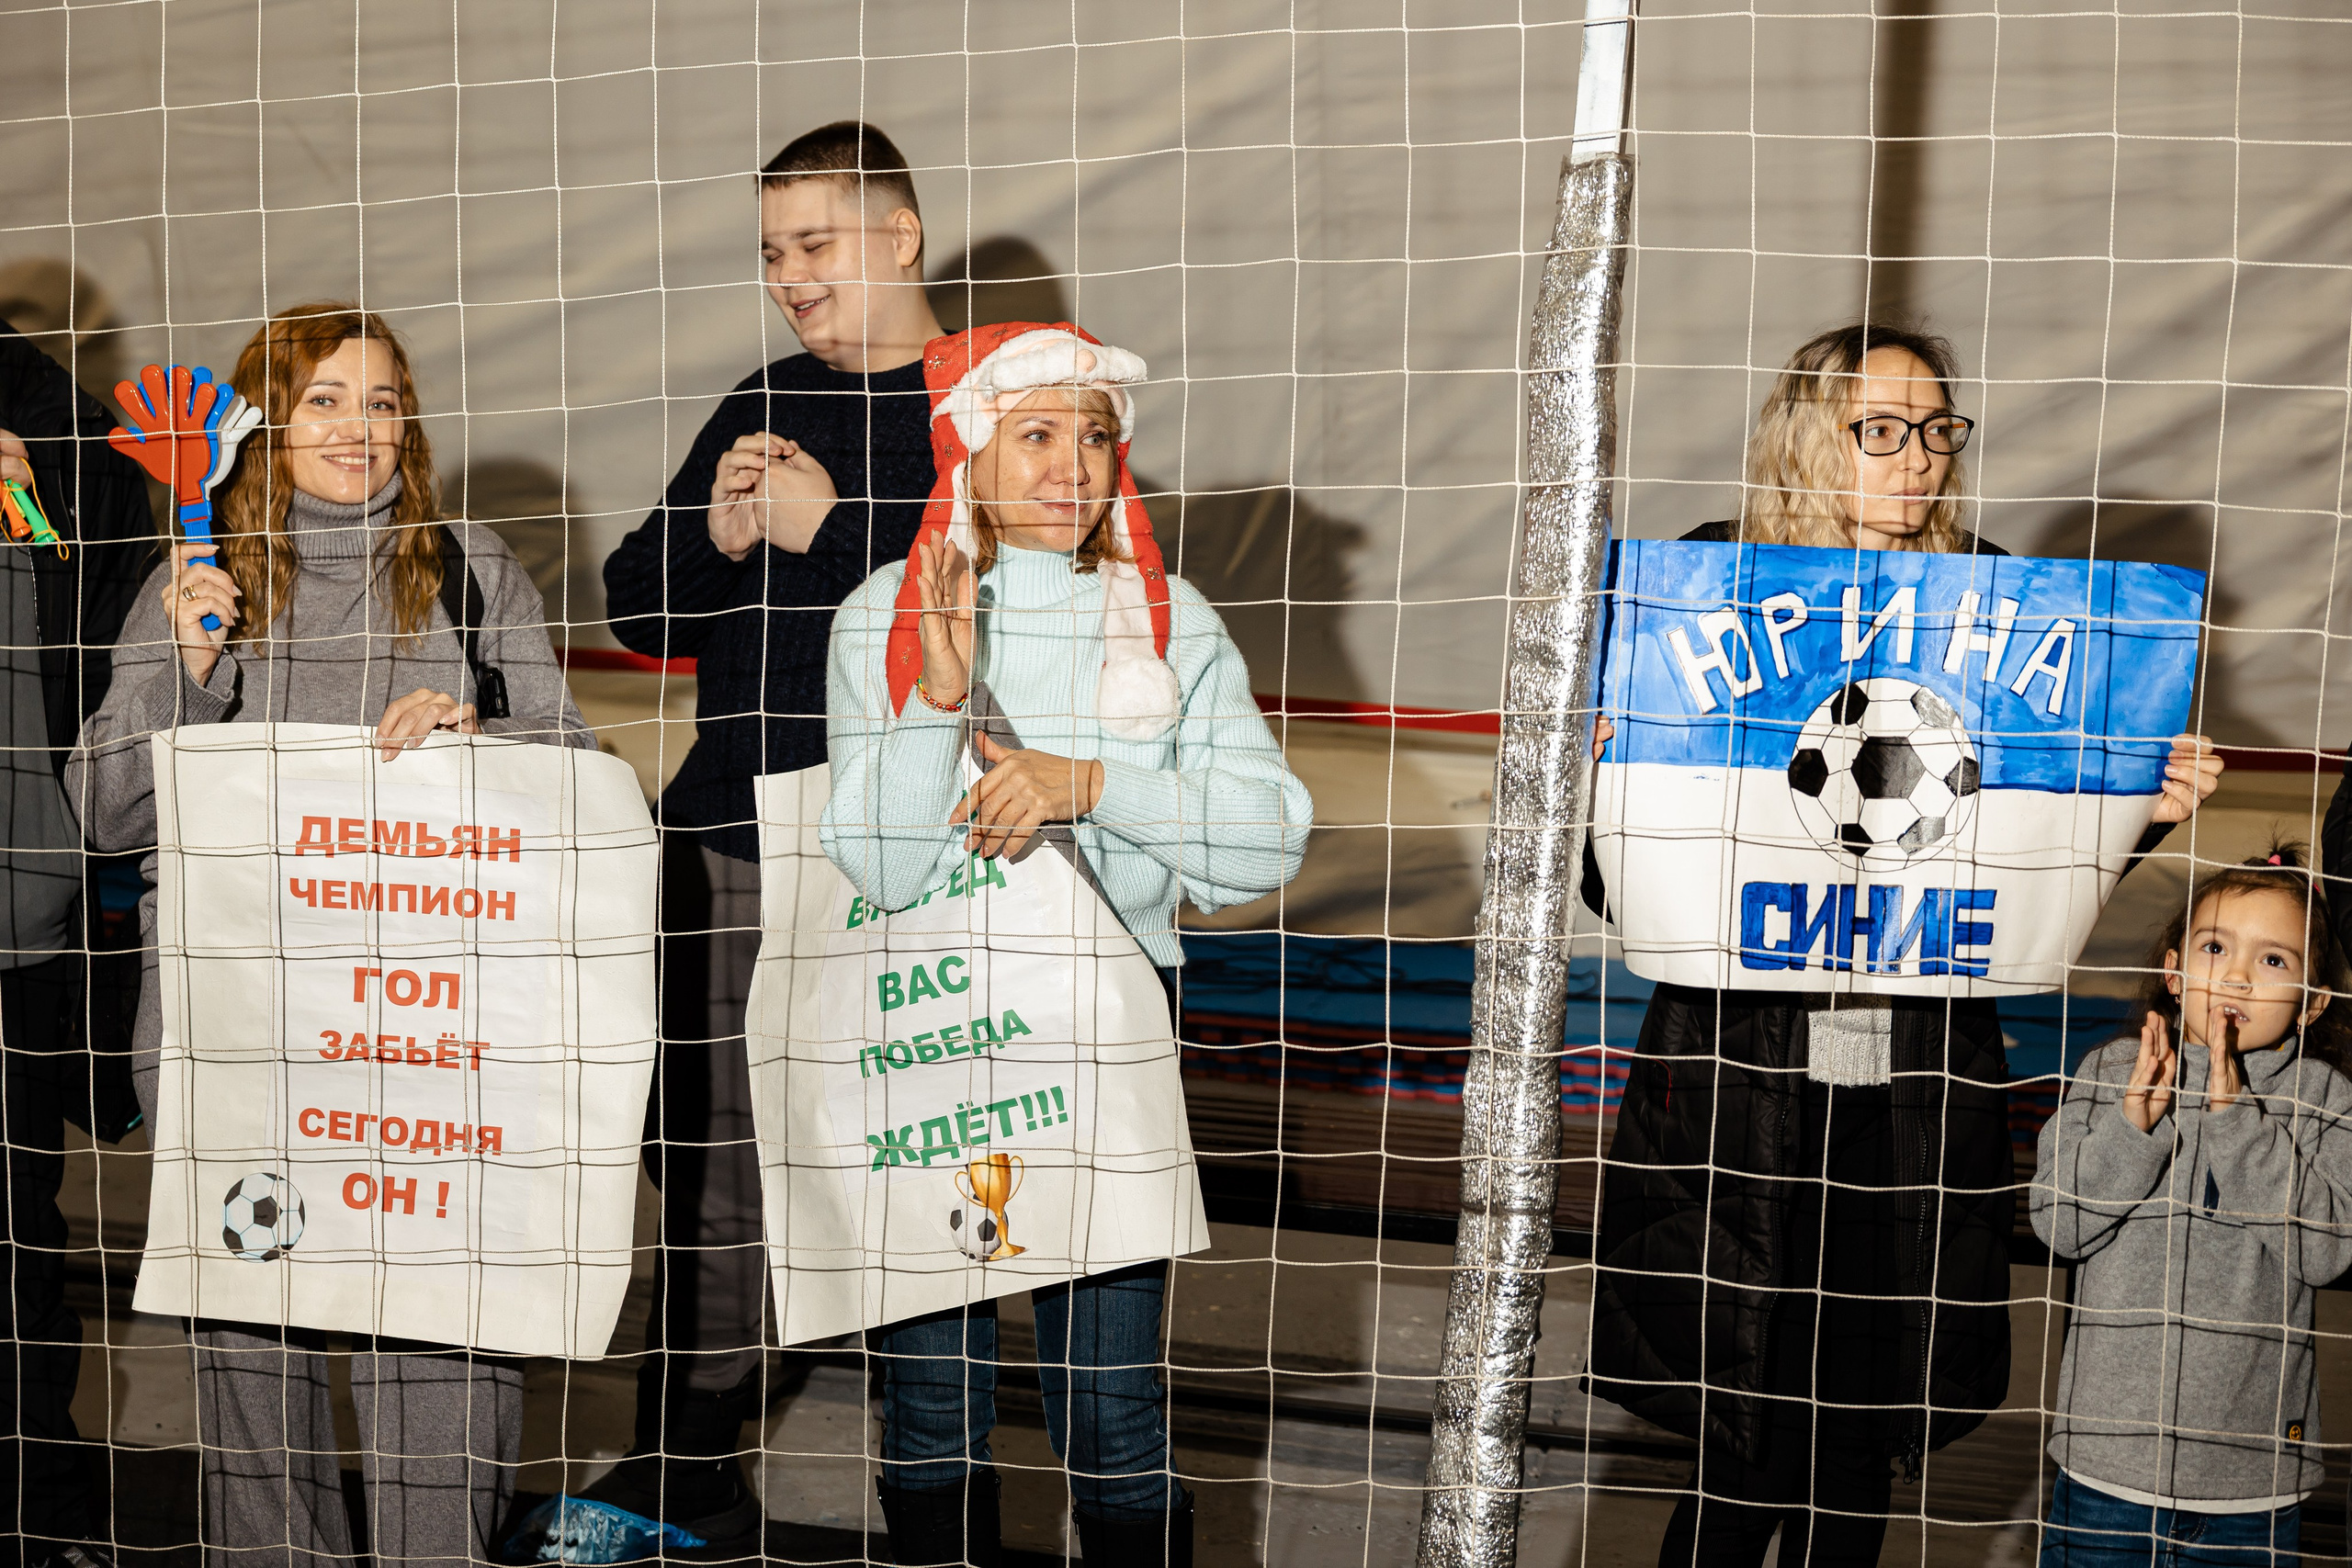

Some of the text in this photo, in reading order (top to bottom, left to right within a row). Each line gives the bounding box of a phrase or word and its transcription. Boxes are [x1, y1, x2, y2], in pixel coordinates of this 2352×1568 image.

[1667, 586, 2076, 716] ЮРИНА
[294, 816, 521, 863] ДЕМЬЯН
[288, 877, 516, 921] ЧЕМПИОН
[1740, 881, 1998, 976] СИНИЕ
[352, 966, 460, 1010] ГОЛ
[876, 956, 972, 1012] ВАС
[318, 1030, 491, 1071] ЗАБЬЁТ
[858, 1009, 1033, 1077] ПОБЕДА
[298, 1108, 503, 1156] СЕГОДНЯ
[866, 1086, 1069, 1172] ЖДЁТ!!!
